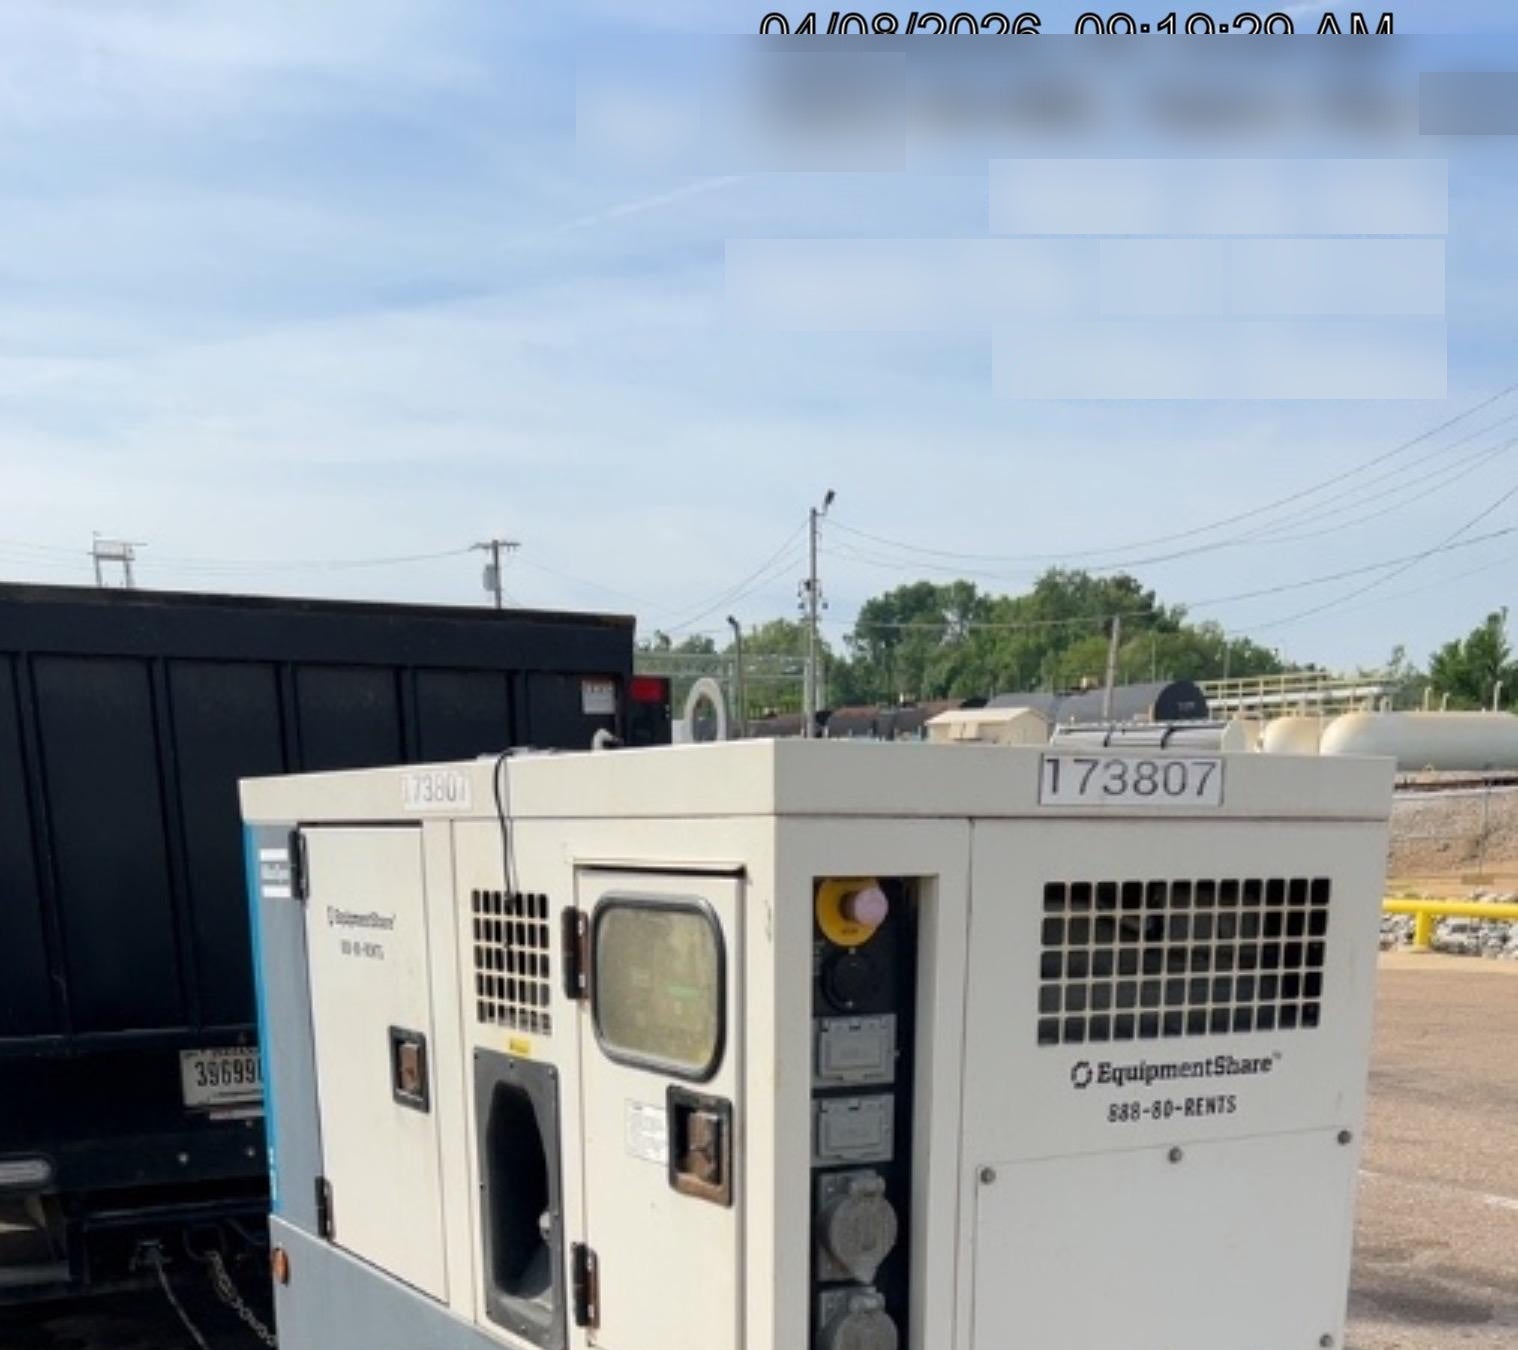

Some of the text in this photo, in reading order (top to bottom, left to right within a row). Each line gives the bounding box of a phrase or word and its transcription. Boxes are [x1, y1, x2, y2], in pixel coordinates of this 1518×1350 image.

[1045, 758, 1217, 796] 173807
[1096, 1054, 1273, 1087] EquipmentShare
[1106, 1094, 1237, 1123] 888-80-RENTS
